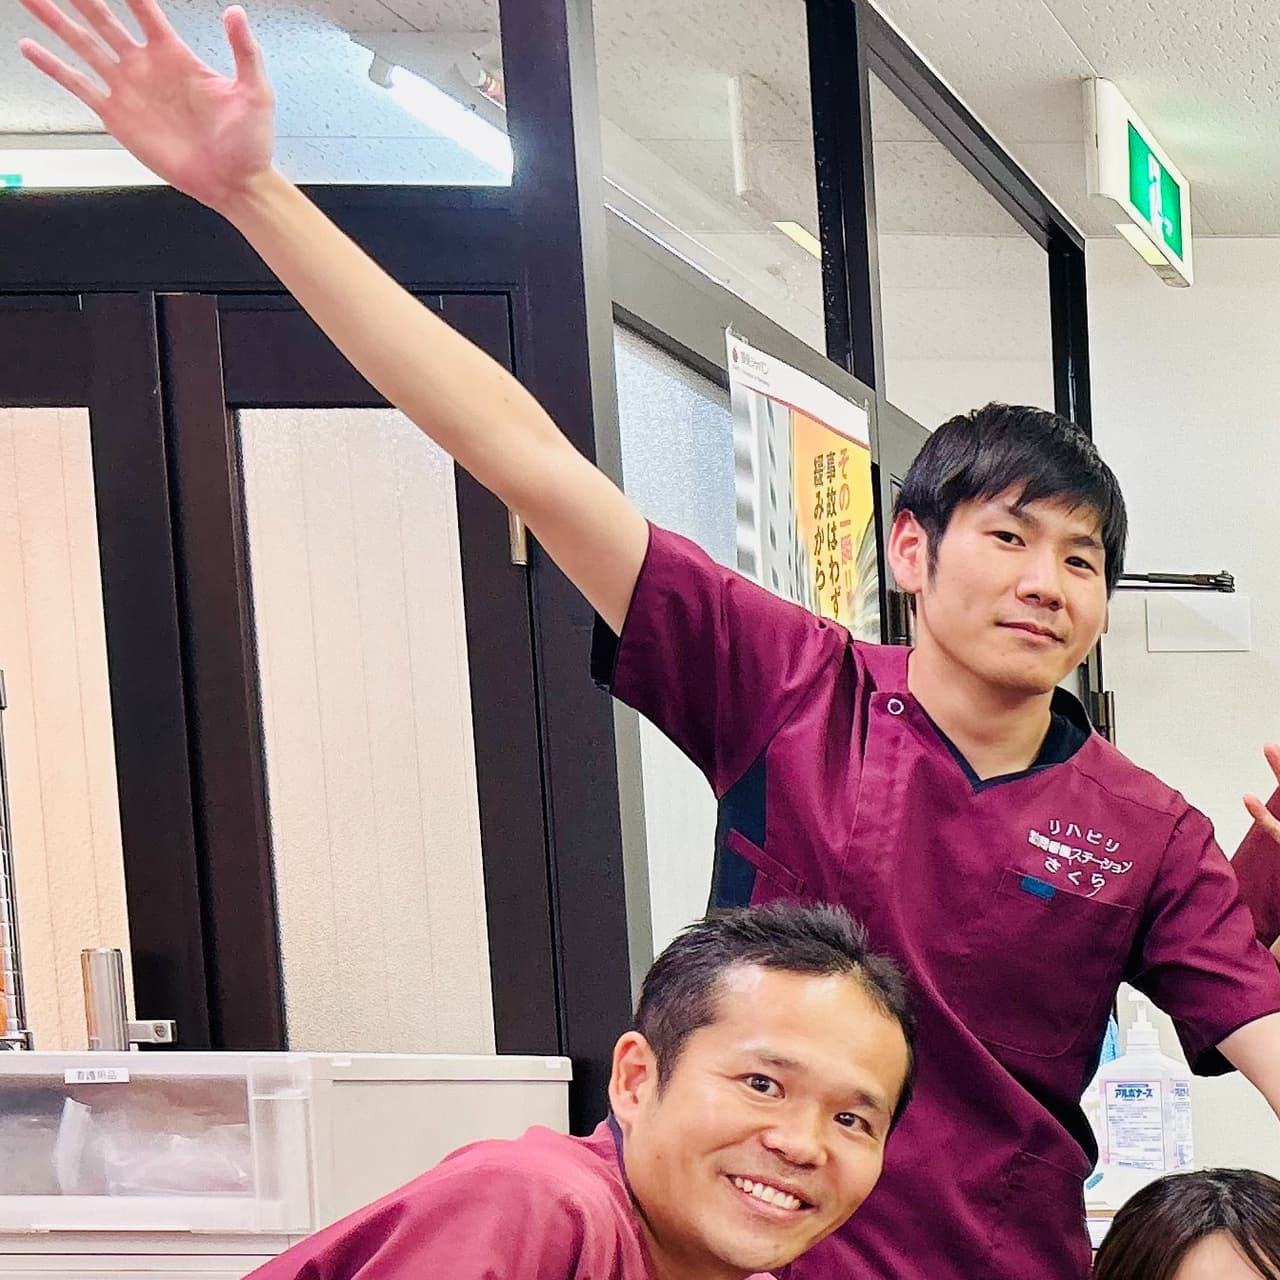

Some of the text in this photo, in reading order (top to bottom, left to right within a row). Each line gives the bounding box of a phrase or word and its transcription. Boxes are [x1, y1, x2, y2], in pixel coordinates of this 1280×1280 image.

[1049, 819, 1120, 852] リハビリ
[1044, 856, 1105, 888] さくら
